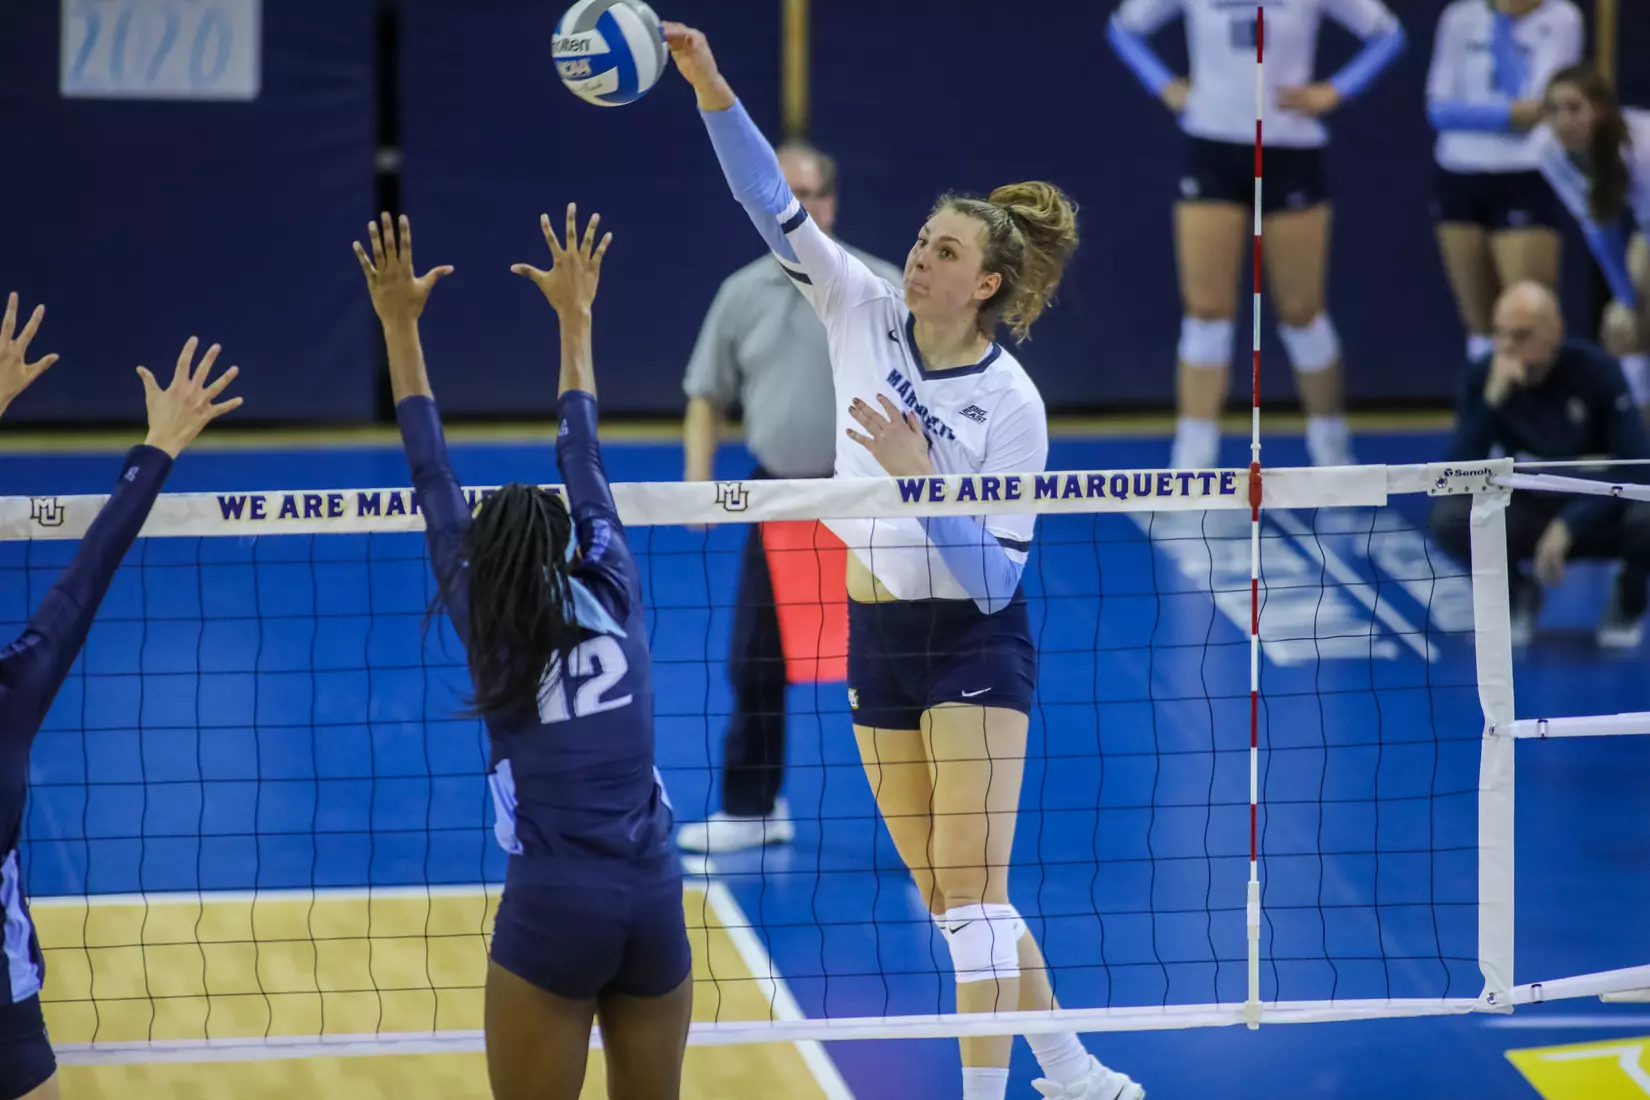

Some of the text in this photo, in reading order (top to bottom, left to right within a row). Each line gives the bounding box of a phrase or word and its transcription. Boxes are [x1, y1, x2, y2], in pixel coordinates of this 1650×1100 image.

[962, 408, 987, 423] EAST
[968, 404, 987, 417] BIG
[897, 471, 1237, 503] WE ARE MARQUETTE
[217, 495, 268, 520] WE
[278, 493, 345, 518] ARE
[537, 635, 633, 724] 12
